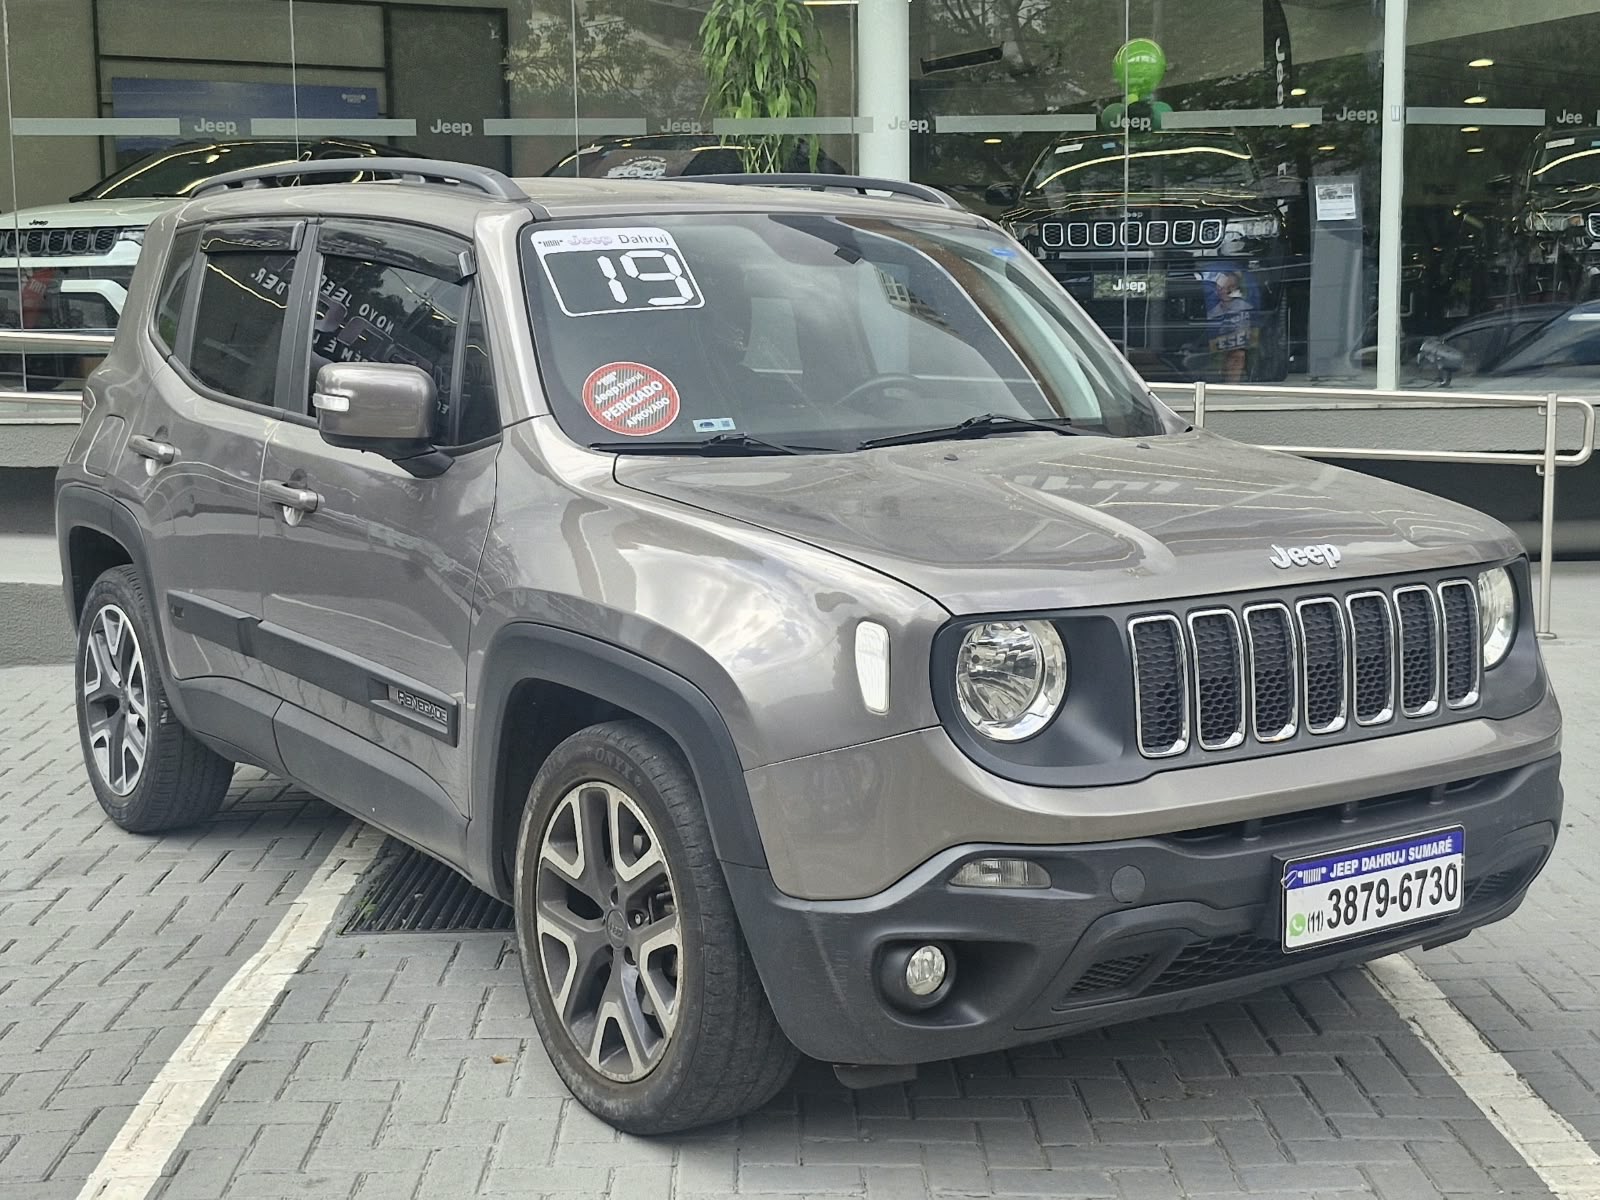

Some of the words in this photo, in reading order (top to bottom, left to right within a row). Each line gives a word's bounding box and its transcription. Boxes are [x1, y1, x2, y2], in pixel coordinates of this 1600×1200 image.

[1109, 113, 1152, 132] Jeep
[1335, 106, 1379, 124] Jeep
[194, 117, 238, 136] Jeep
[430, 118, 473, 137] Jeep
[660, 118, 702, 135] Jeep
[888, 116, 929, 134] Jeep
[567, 235, 613, 246] Jeep
[618, 234, 670, 246] Dahruj
[597, 249, 695, 306] 19
[1112, 278, 1147, 293] Jeep
[594, 385, 621, 405] Jeep
[602, 380, 664, 422] PERICIADO
[626, 397, 671, 428] APROVADO
[1269, 542, 1341, 570] Jeep
[397, 688, 448, 726] RENEGADE
[1329, 858, 1359, 879] JEEP
[1361, 851, 1406, 871] DAHRUJ
[1407, 836, 1453, 861] SUMARÉ
[1307, 910, 1324, 935] (11)
[1326, 862, 1459, 930] 3879-6730
